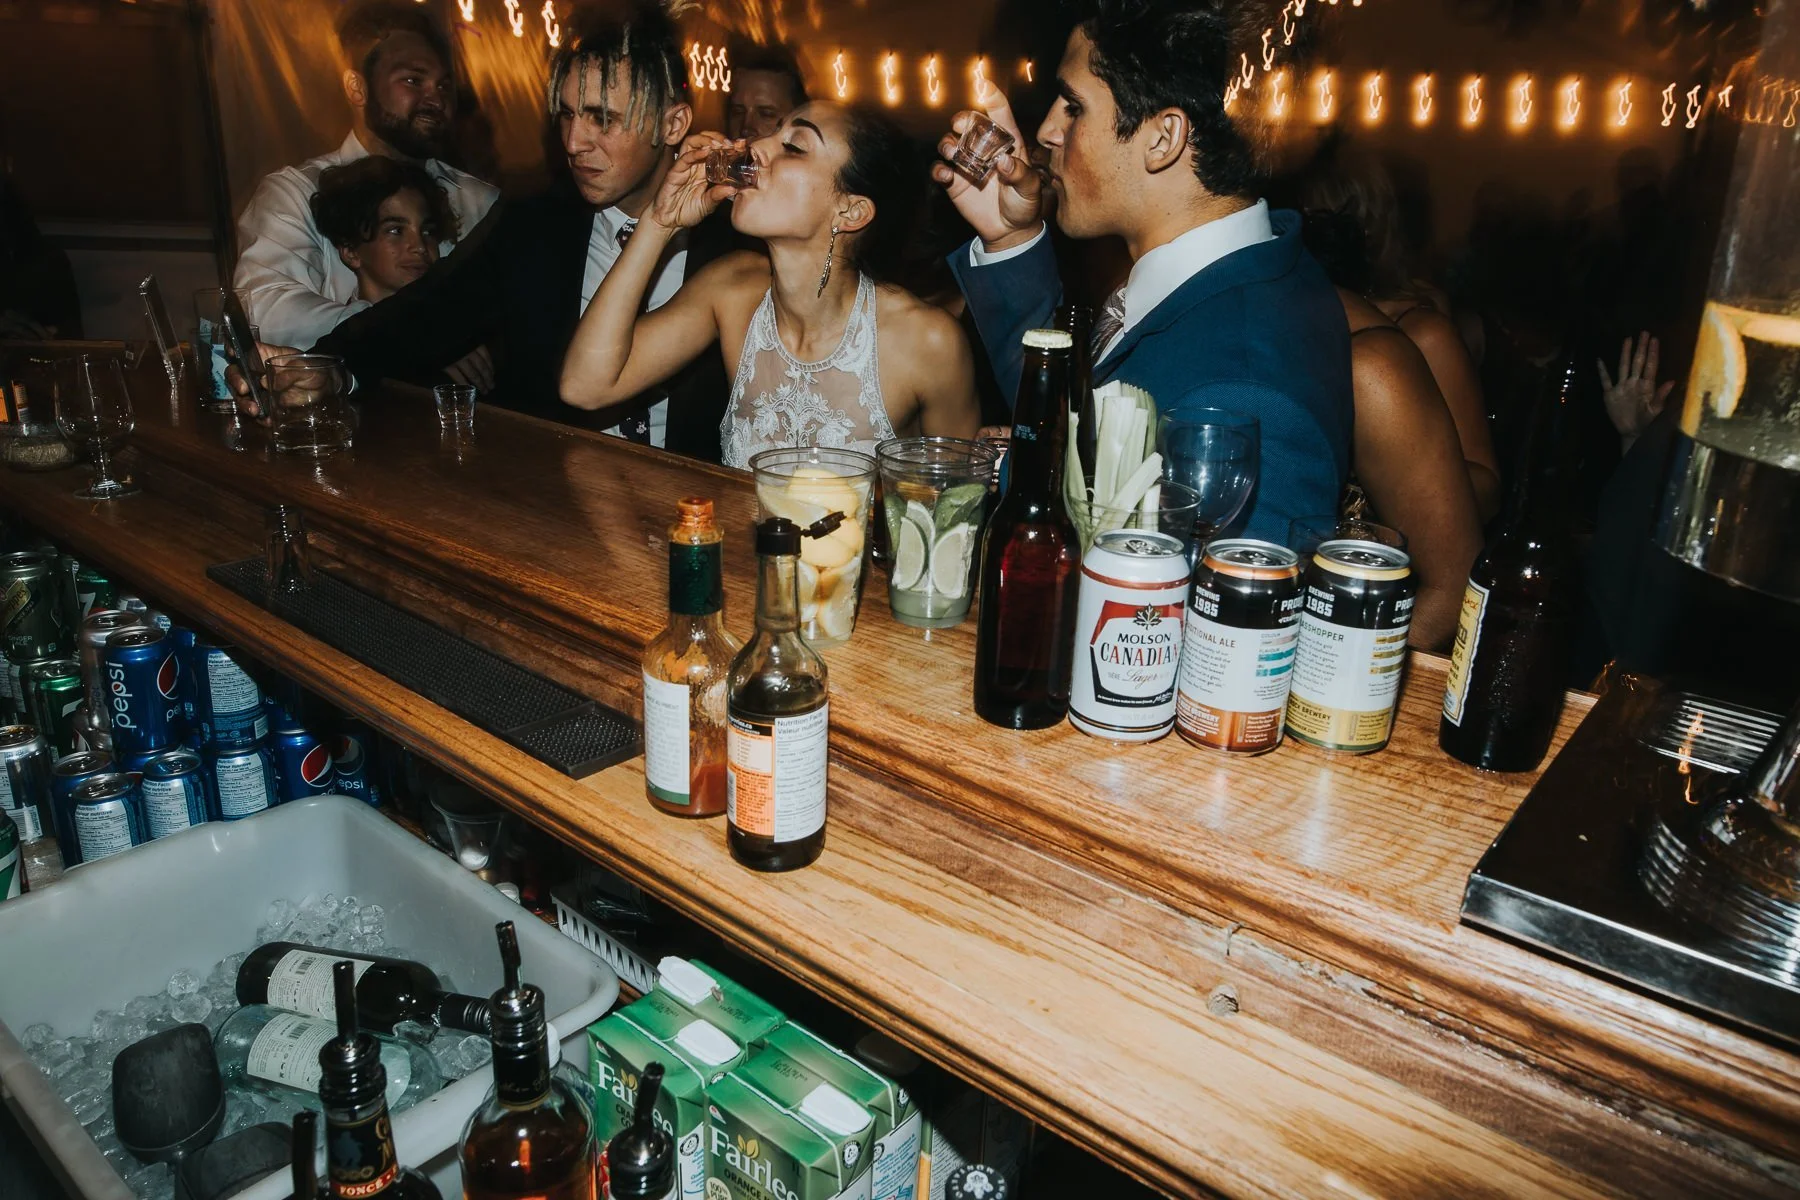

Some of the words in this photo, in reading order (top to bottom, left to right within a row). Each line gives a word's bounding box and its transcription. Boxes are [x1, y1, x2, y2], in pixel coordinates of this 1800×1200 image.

[1194, 596, 1219, 617] 1985
[1306, 596, 1333, 617] 1985
[1117, 632, 1172, 645] MOLSON
[1219, 638, 1236, 648] ALE
[1122, 669, 1158, 690] Lager
[106, 661, 137, 728] pepsi
[1302, 706, 1331, 720] BREWERY
[777, 717, 808, 727] Nutrition
[777, 727, 801, 735] Valeur
[337, 777, 364, 791] epsi
[724, 1168, 761, 1199] ORANGE
